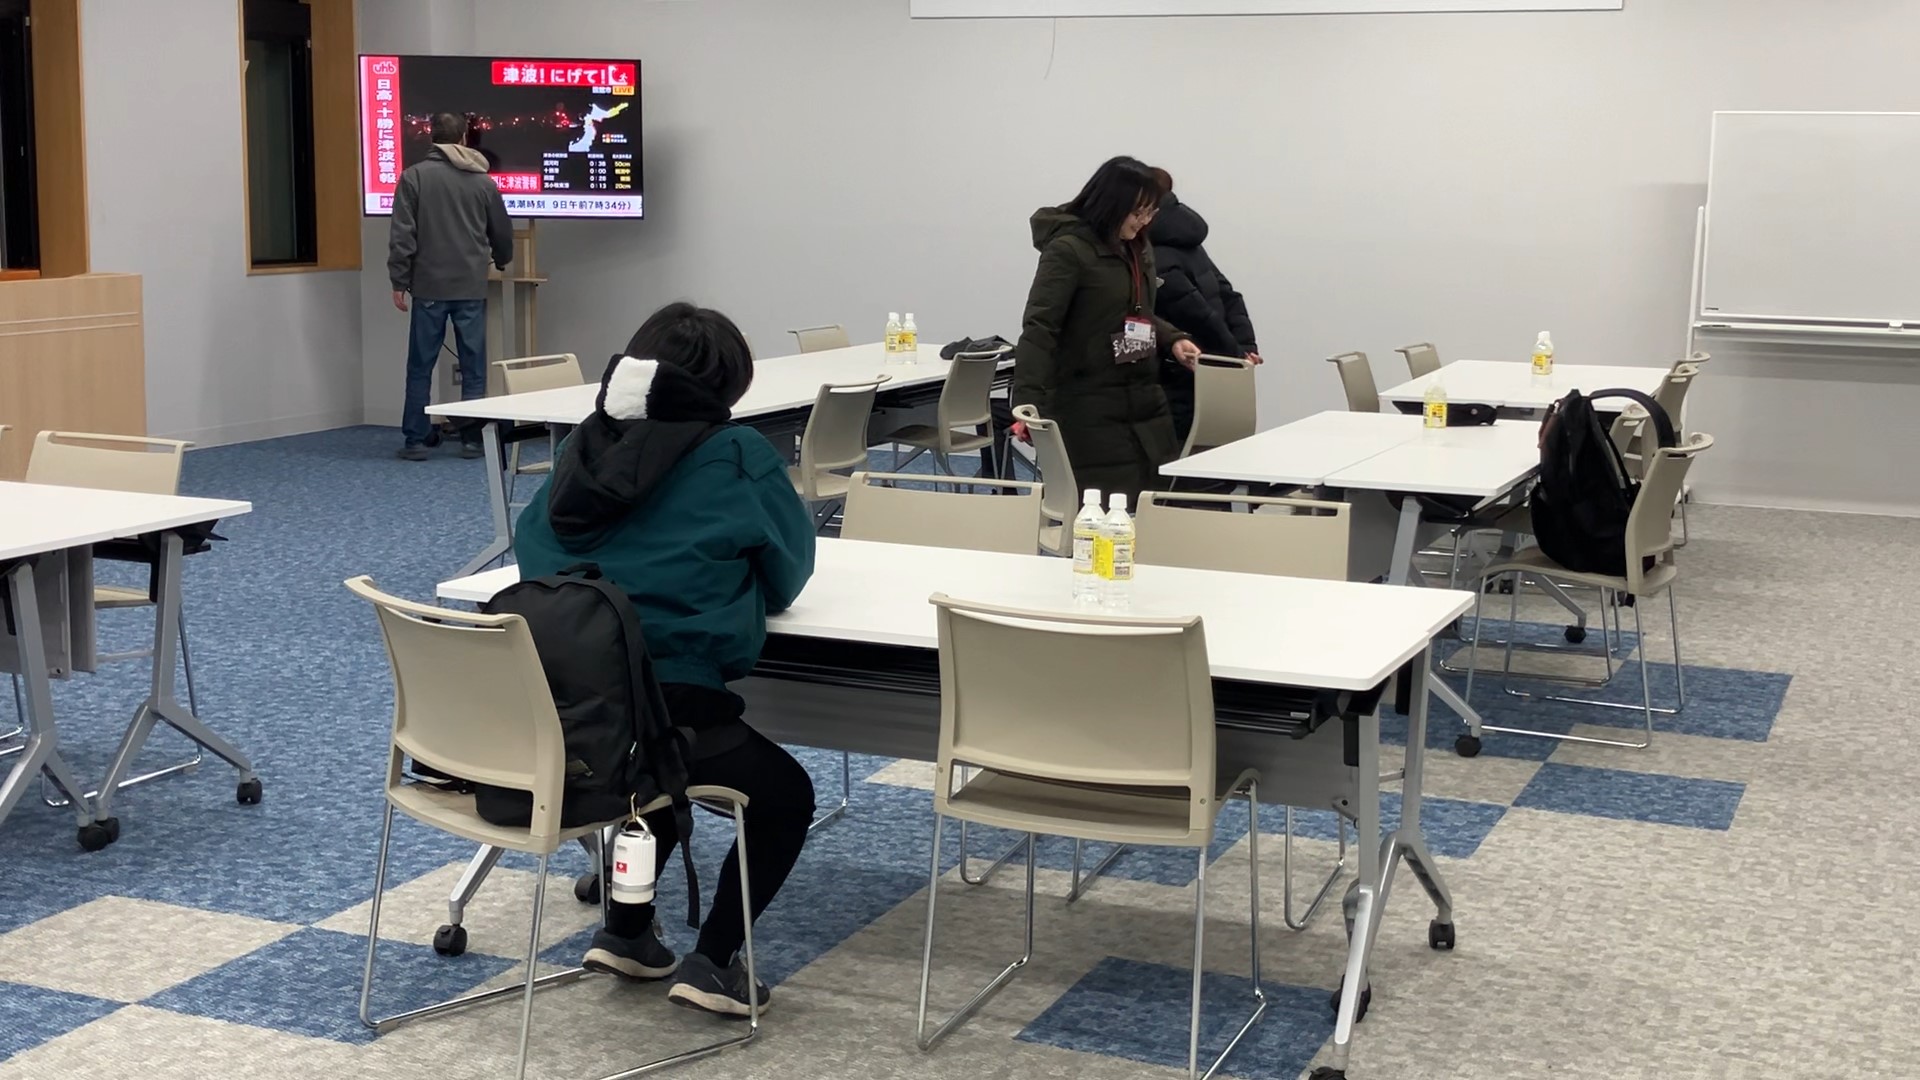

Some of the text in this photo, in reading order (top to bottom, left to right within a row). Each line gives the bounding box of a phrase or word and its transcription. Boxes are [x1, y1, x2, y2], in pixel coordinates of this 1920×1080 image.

[373, 61, 396, 74] uhb
[376, 79, 396, 183] 日高・十勝に津波警報
